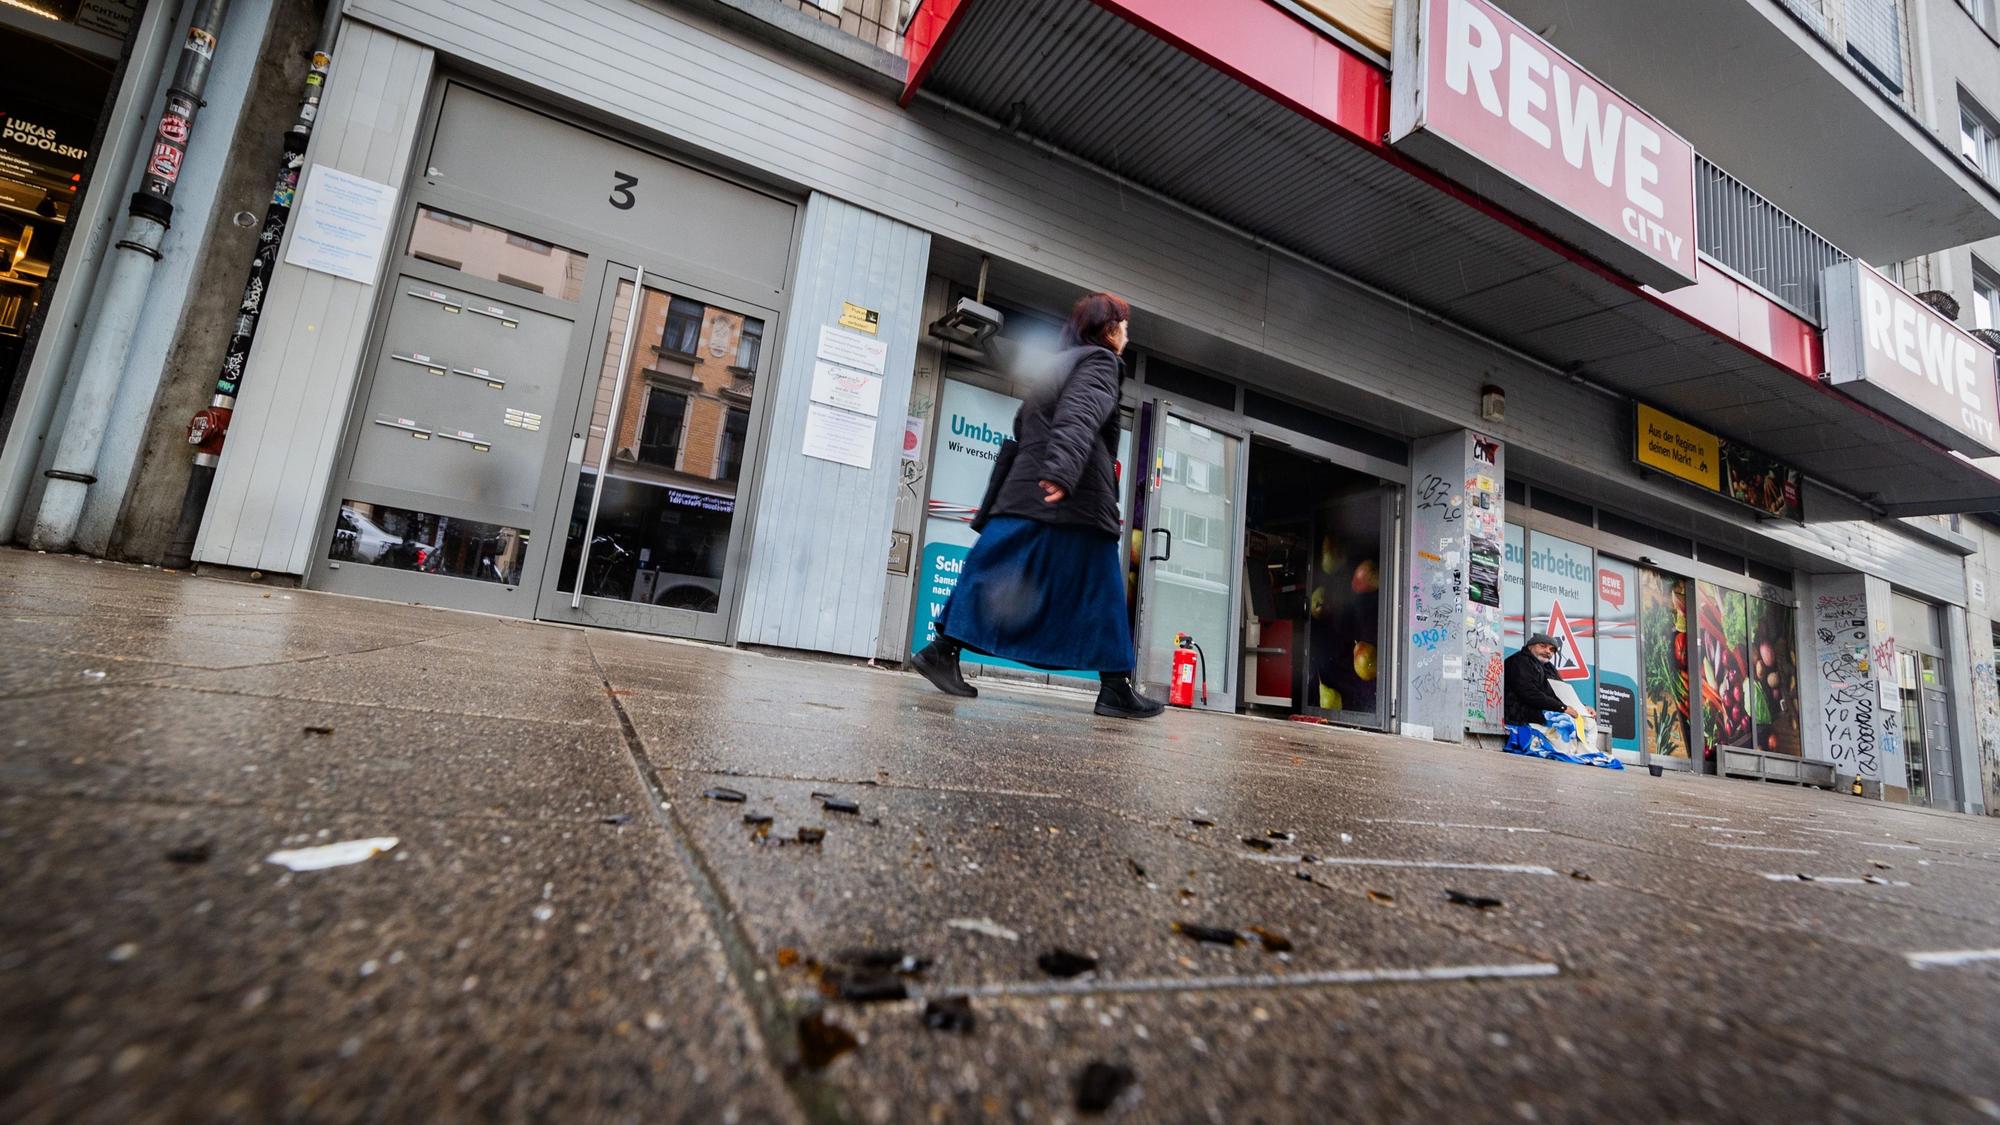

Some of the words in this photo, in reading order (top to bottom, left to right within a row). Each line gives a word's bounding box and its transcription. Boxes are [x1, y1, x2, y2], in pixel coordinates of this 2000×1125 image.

[1446, 0, 1664, 219] REWE
[6, 117, 57, 140] LUKAS
[609, 170, 638, 210] 3
[1622, 207, 1682, 262] CITY
[1866, 277, 1981, 412] REWE
[1961, 407, 1993, 441] CITY
[948, 441, 964, 453] Wir
[1648, 423, 1661, 439] Aus
[1663, 430, 1674, 442] der
[1675, 434, 1697, 453] Region
[1698, 446, 1704, 456] in
[1648, 440, 1670, 457] deinen
[1672, 448, 1692, 466] Markt
[935, 555, 966, 574] Schl
[932, 586, 951, 597] nach
[1531, 580, 1558, 594] unseren
[1558, 586, 1580, 600] Markt!
[1601, 575, 1621, 589] REWE
